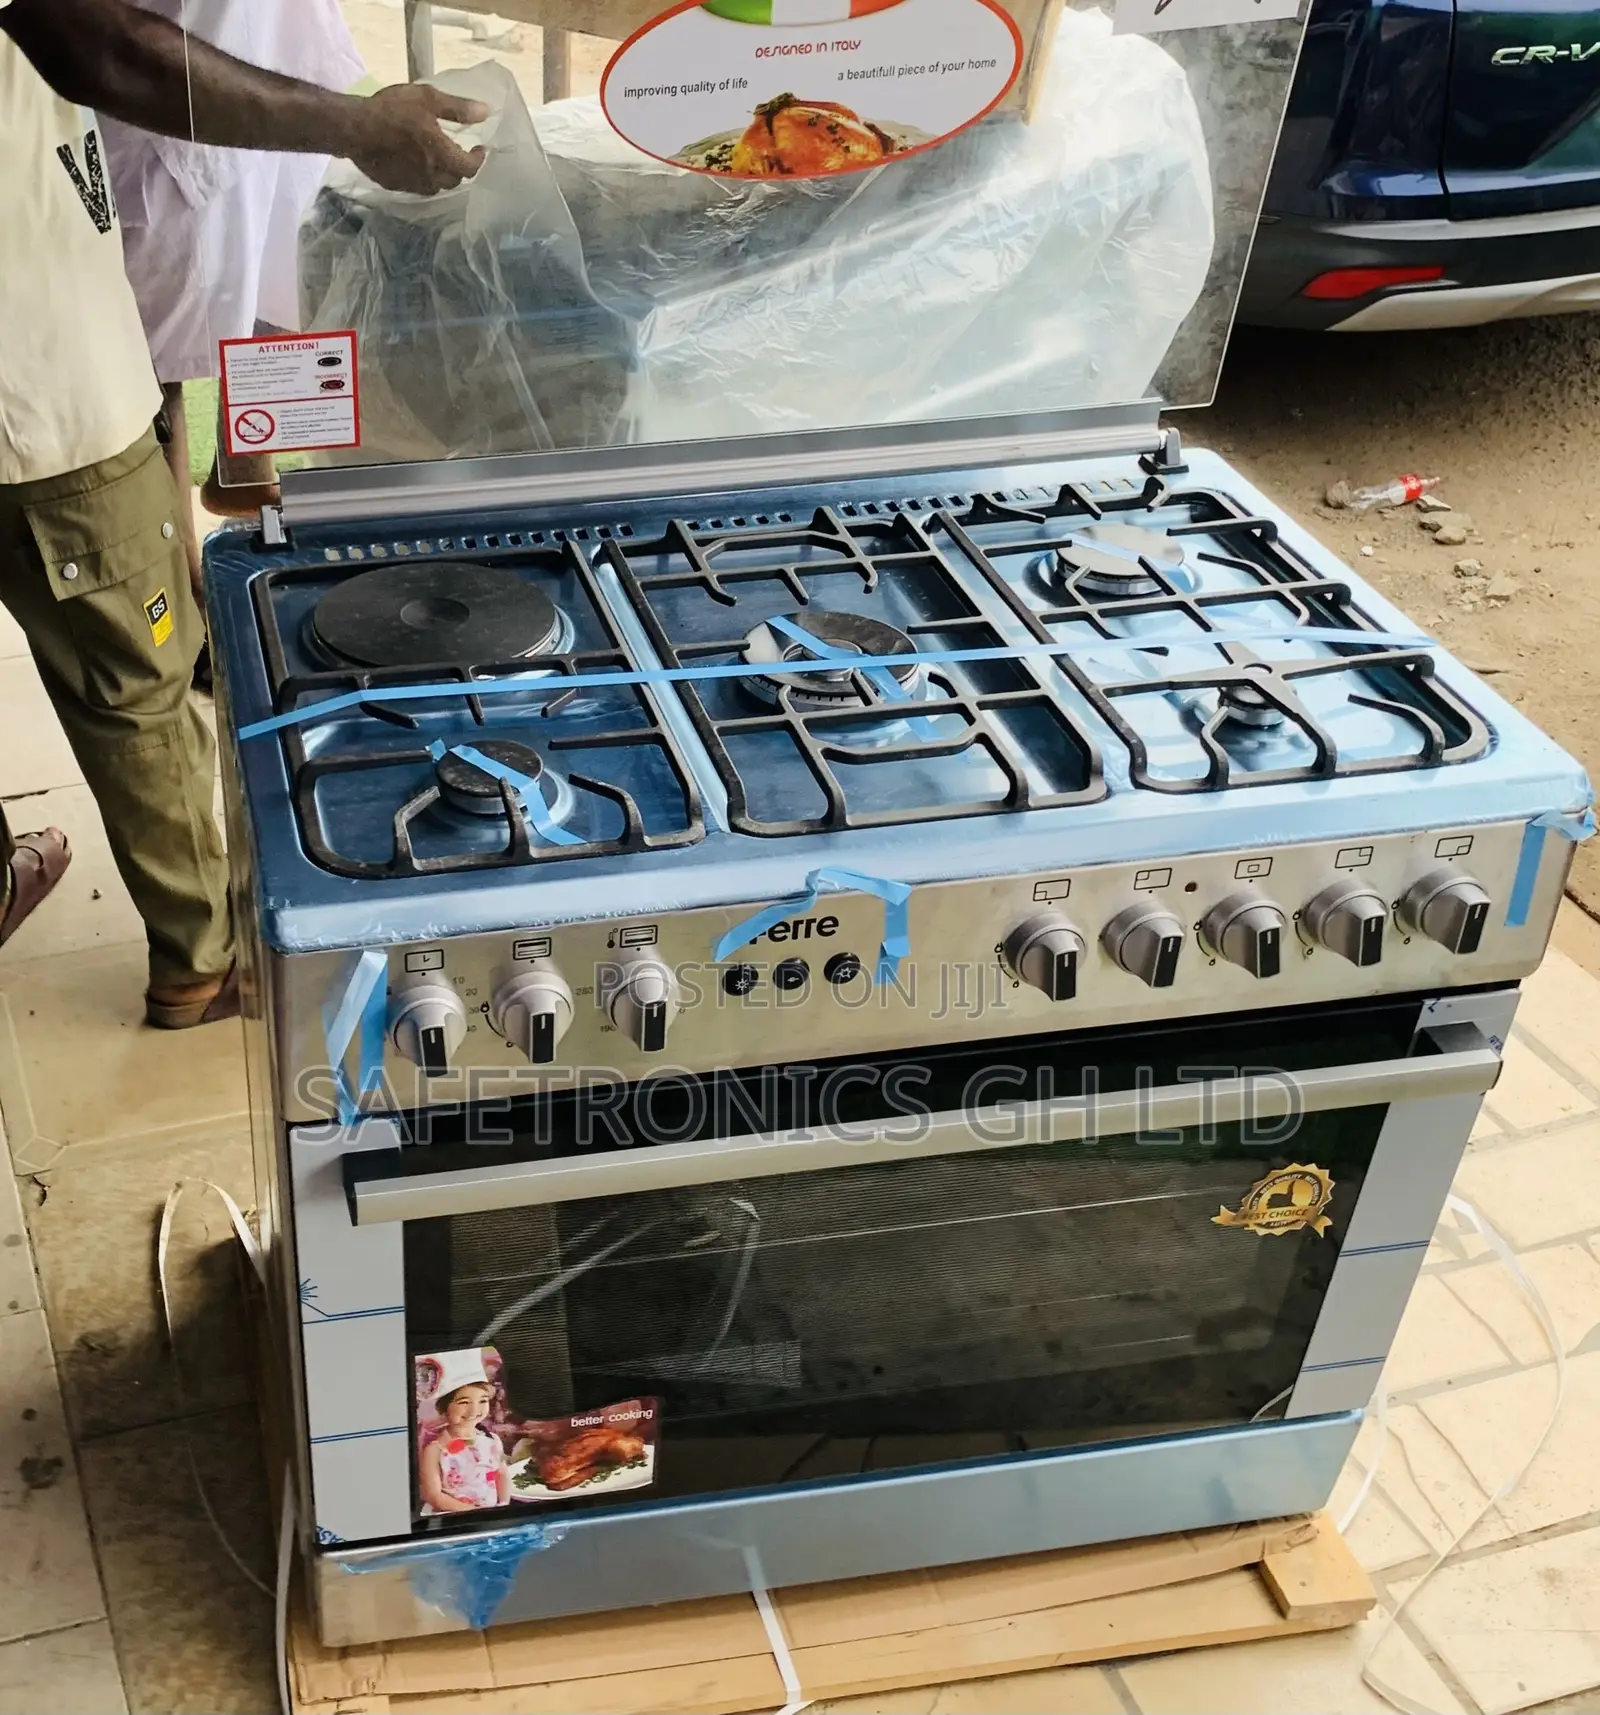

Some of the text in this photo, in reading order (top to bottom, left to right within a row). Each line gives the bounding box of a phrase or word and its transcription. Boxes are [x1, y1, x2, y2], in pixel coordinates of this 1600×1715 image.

[755, 43, 813, 58] DESIGNED
[816, 42, 828, 53] IN
[1491, 42, 1600, 66] CR-V
[837, 58, 997, 81] a beautifull piece of your home
[624, 77, 748, 99] improving quality of life
[258, 341, 319, 354] ATTENTION!
[570, 1409, 654, 1428] better cooking
